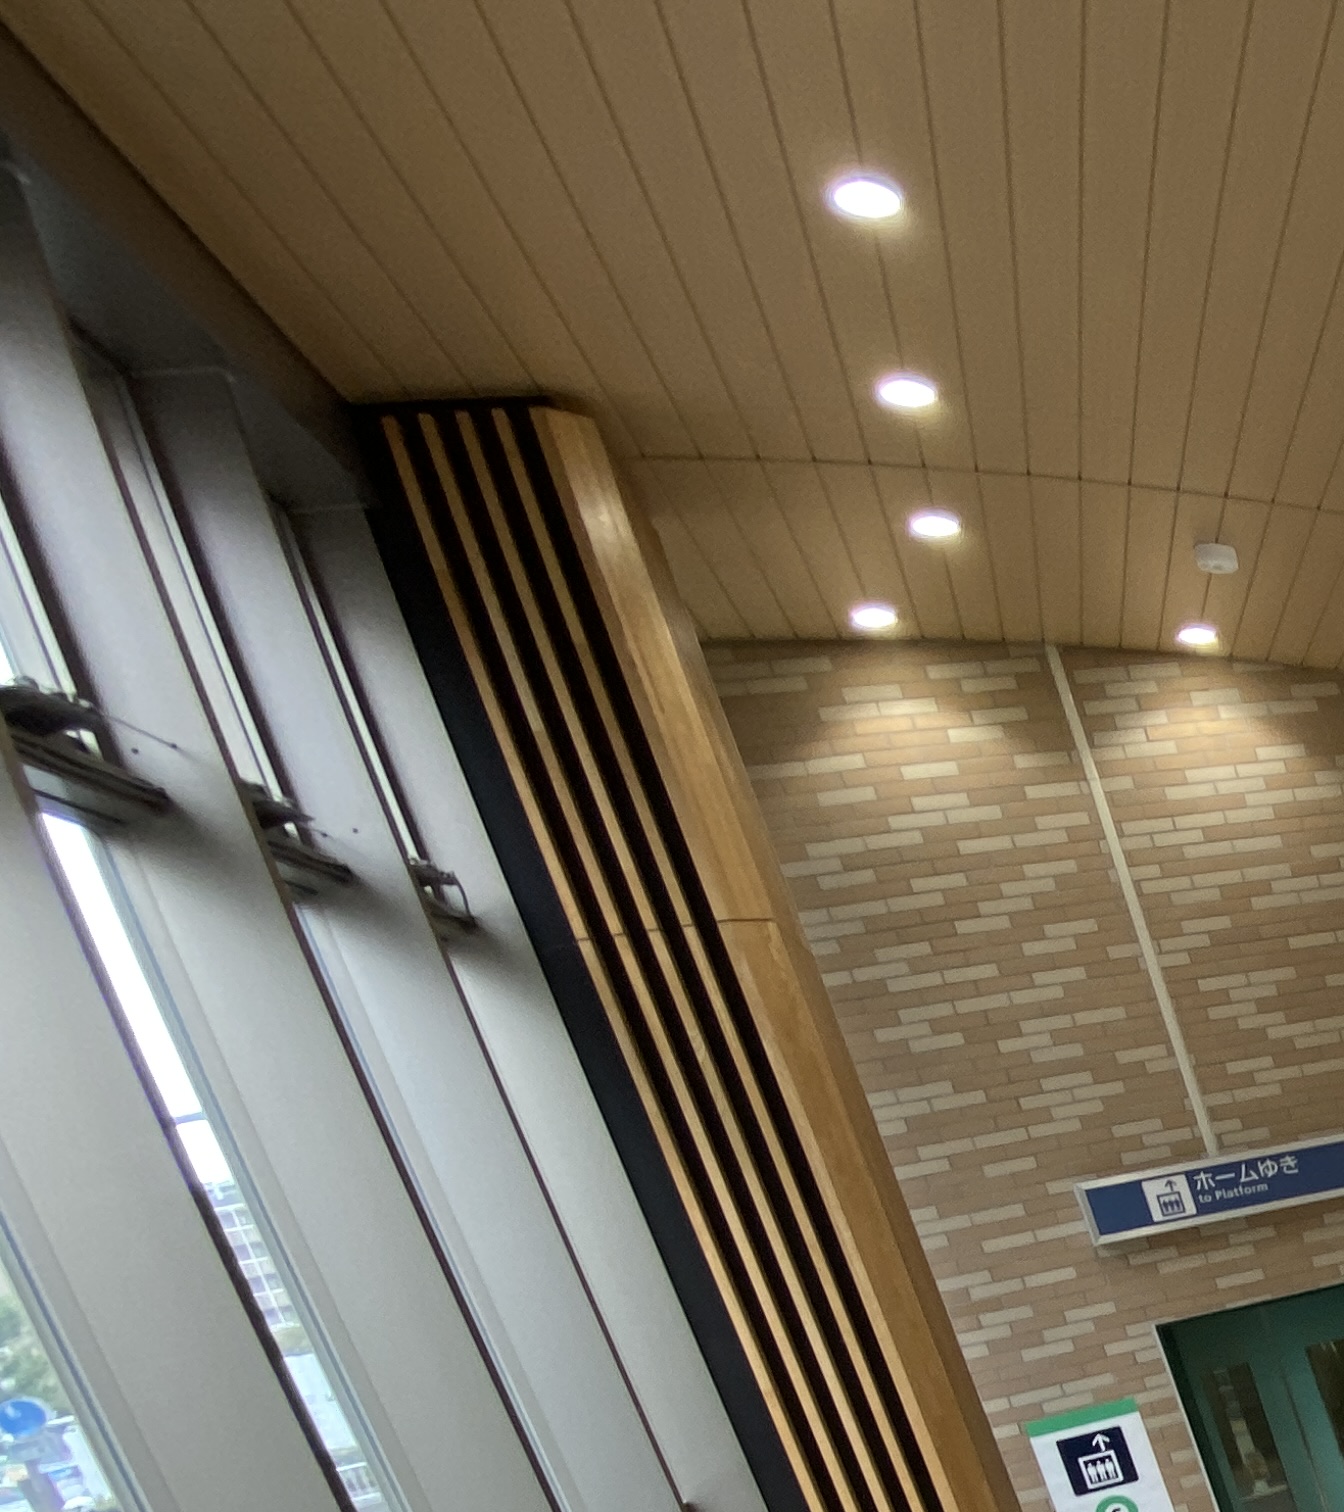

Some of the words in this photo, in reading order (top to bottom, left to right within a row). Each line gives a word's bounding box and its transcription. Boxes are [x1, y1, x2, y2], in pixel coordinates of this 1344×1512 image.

[1194, 1155, 1299, 1190] ホームゆき
[1199, 1193, 1212, 1203] to
[1216, 1182, 1269, 1200] Platform
